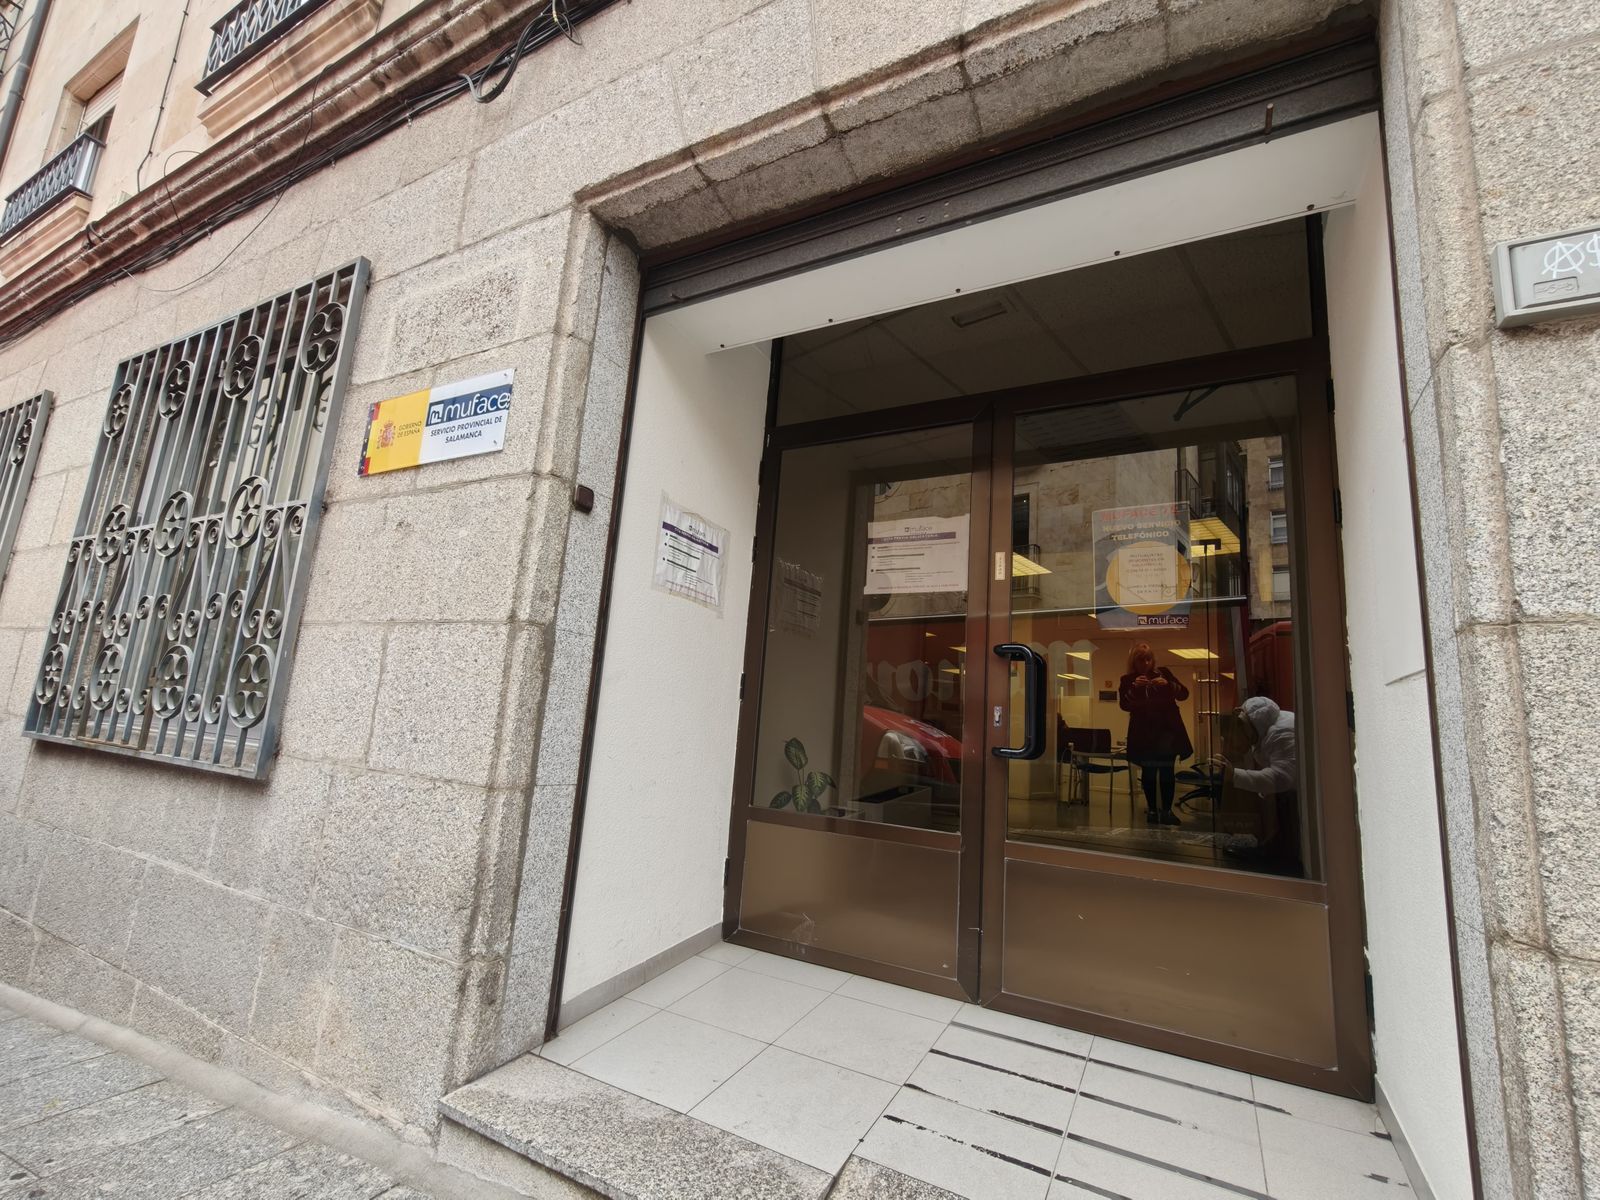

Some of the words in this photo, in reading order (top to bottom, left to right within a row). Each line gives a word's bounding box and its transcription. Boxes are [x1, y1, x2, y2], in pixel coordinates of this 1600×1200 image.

[444, 392, 510, 421] muface
[398, 421, 422, 431] GOBIERNO
[430, 425, 456, 437] SERVICIO
[457, 417, 493, 431] PROVINCIAL
[495, 415, 502, 423] DE
[403, 428, 421, 437] ESPAÑA
[445, 430, 483, 444] SALAMANCA
[1136, 520, 1180, 530] SERVICIO
[1112, 530, 1169, 541] TELEFÓNICO
[1148, 614, 1189, 625] muface
